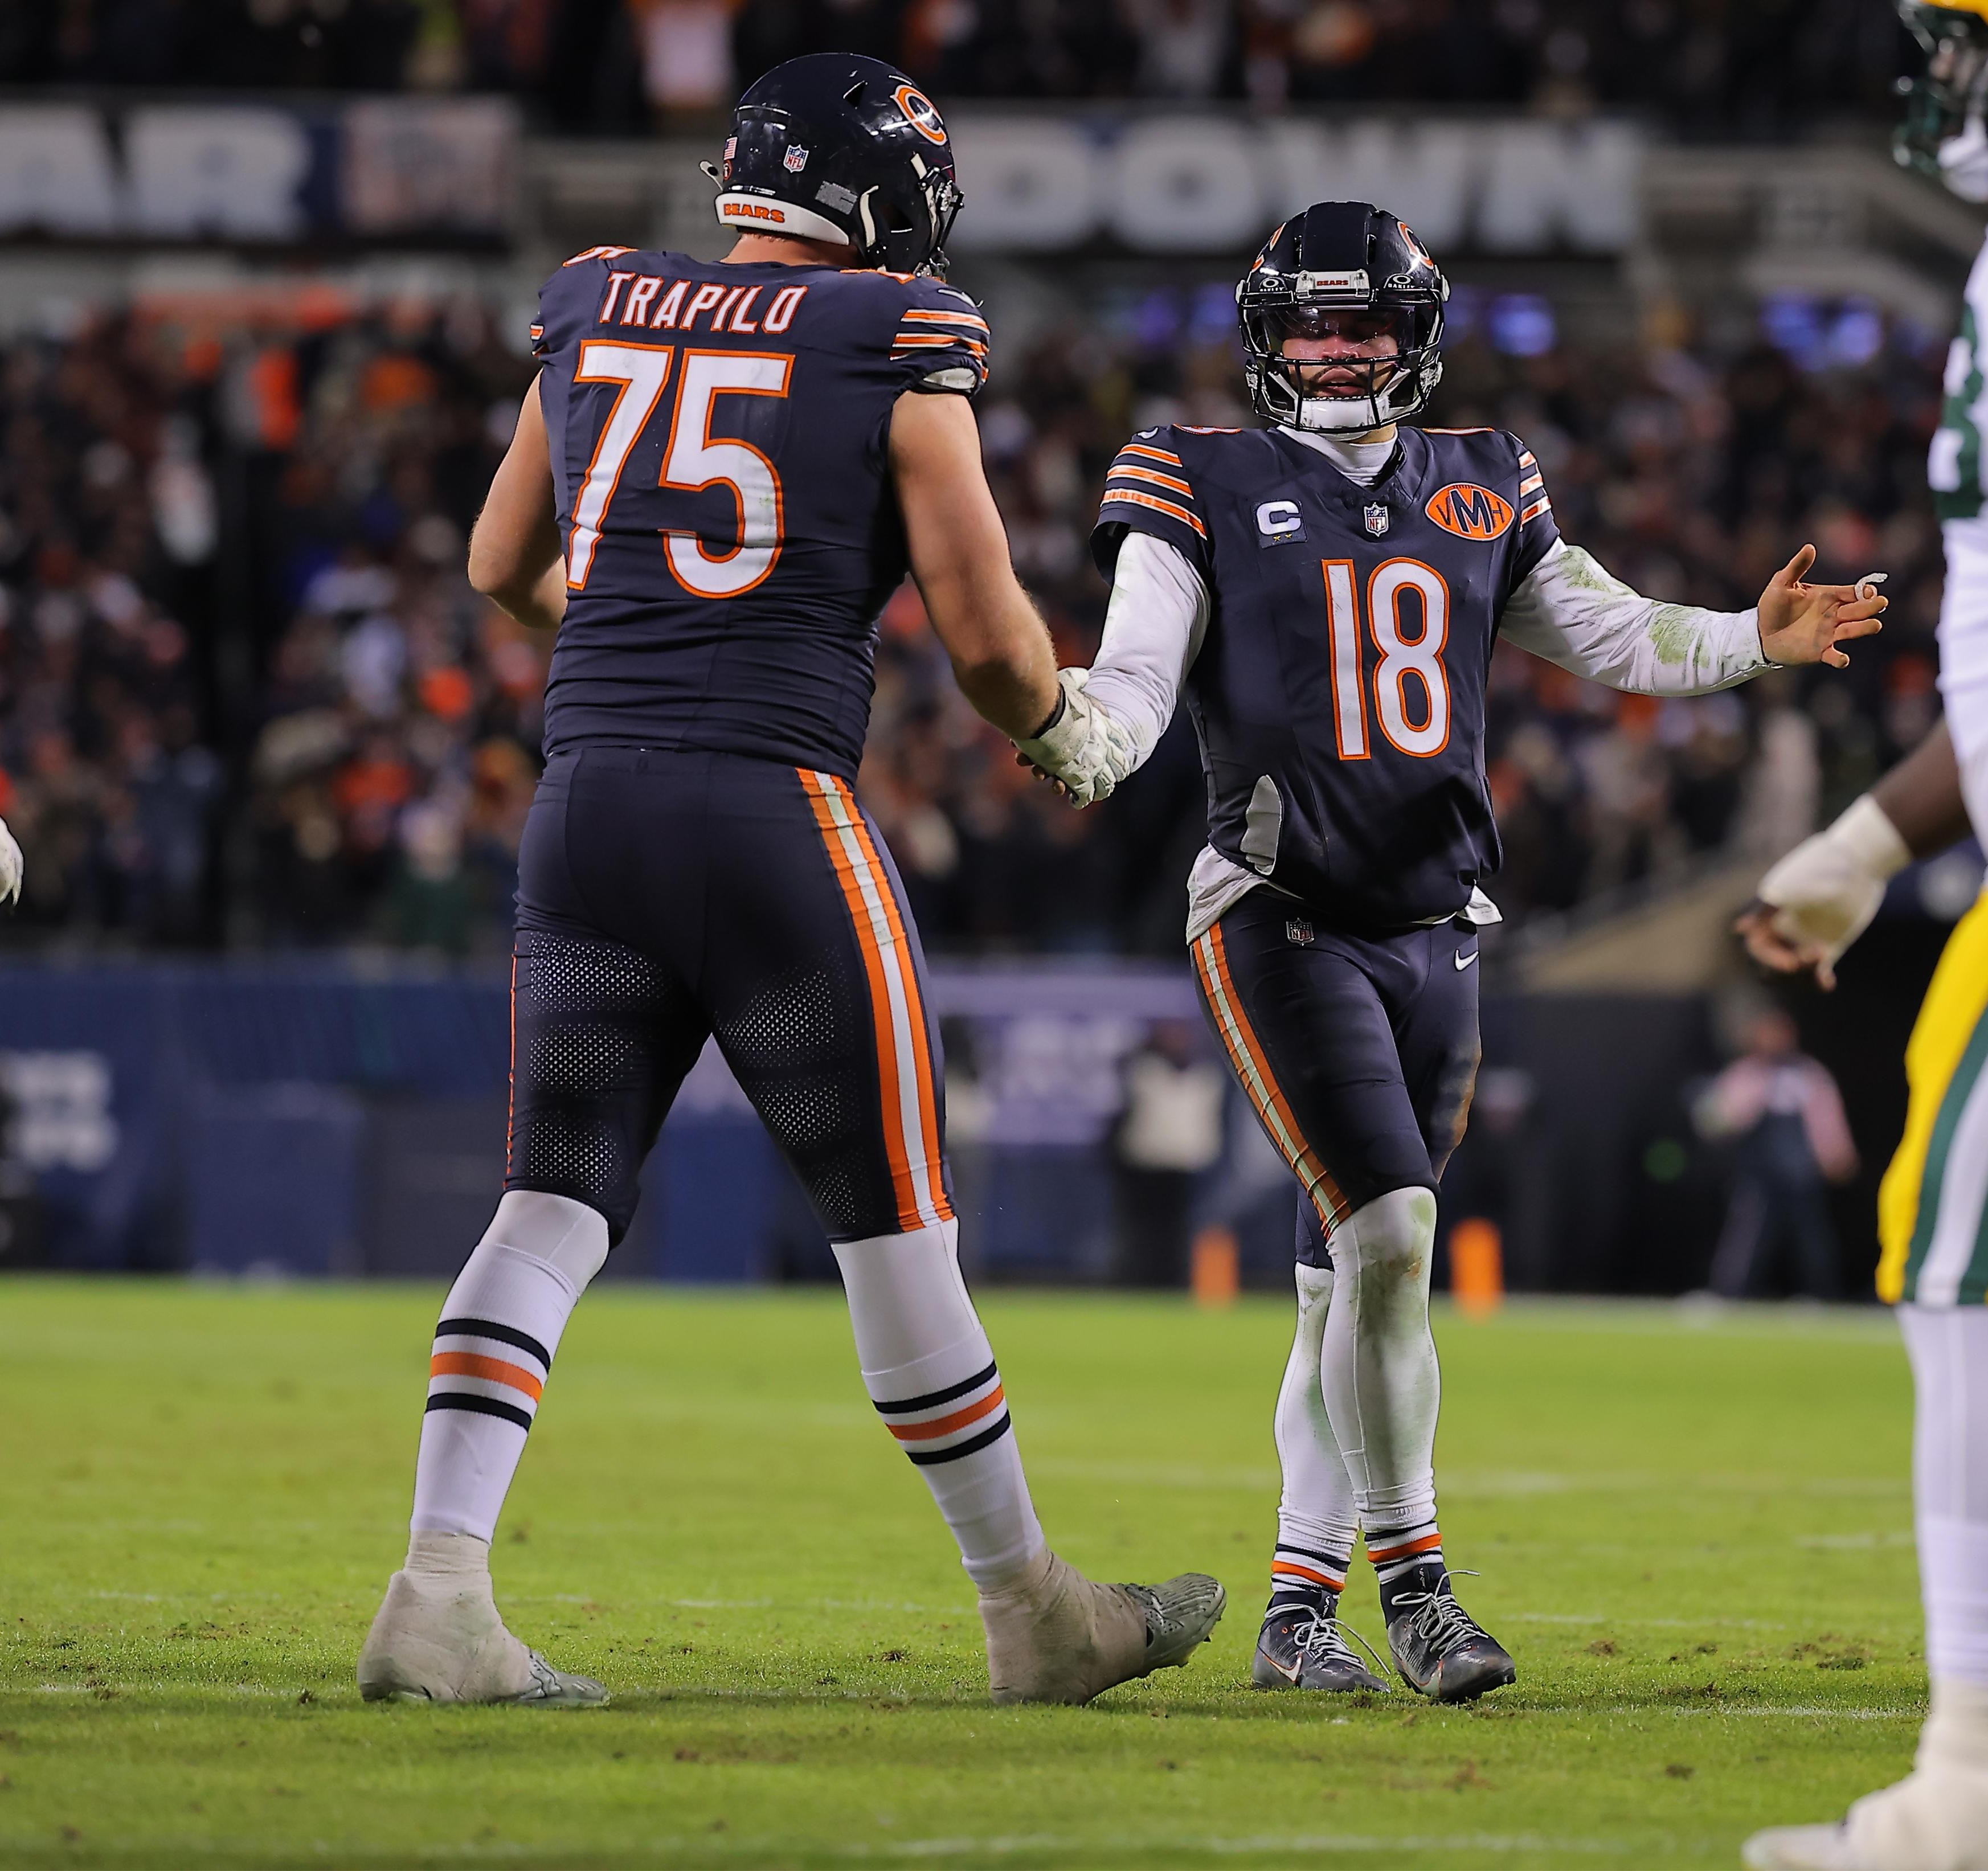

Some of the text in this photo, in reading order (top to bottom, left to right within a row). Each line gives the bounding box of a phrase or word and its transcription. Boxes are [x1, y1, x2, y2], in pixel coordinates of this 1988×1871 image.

[786, 155, 802, 169] NFL
[723, 203, 786, 223] BEARS
[599, 271, 808, 335] TRAPILO
[566, 338, 796, 599] 75
[1257, 501, 1302, 535] C
[1369, 516, 1386, 530] NFL
[1321, 556, 1450, 761] 18
[1291, 929, 1311, 941] NFL
